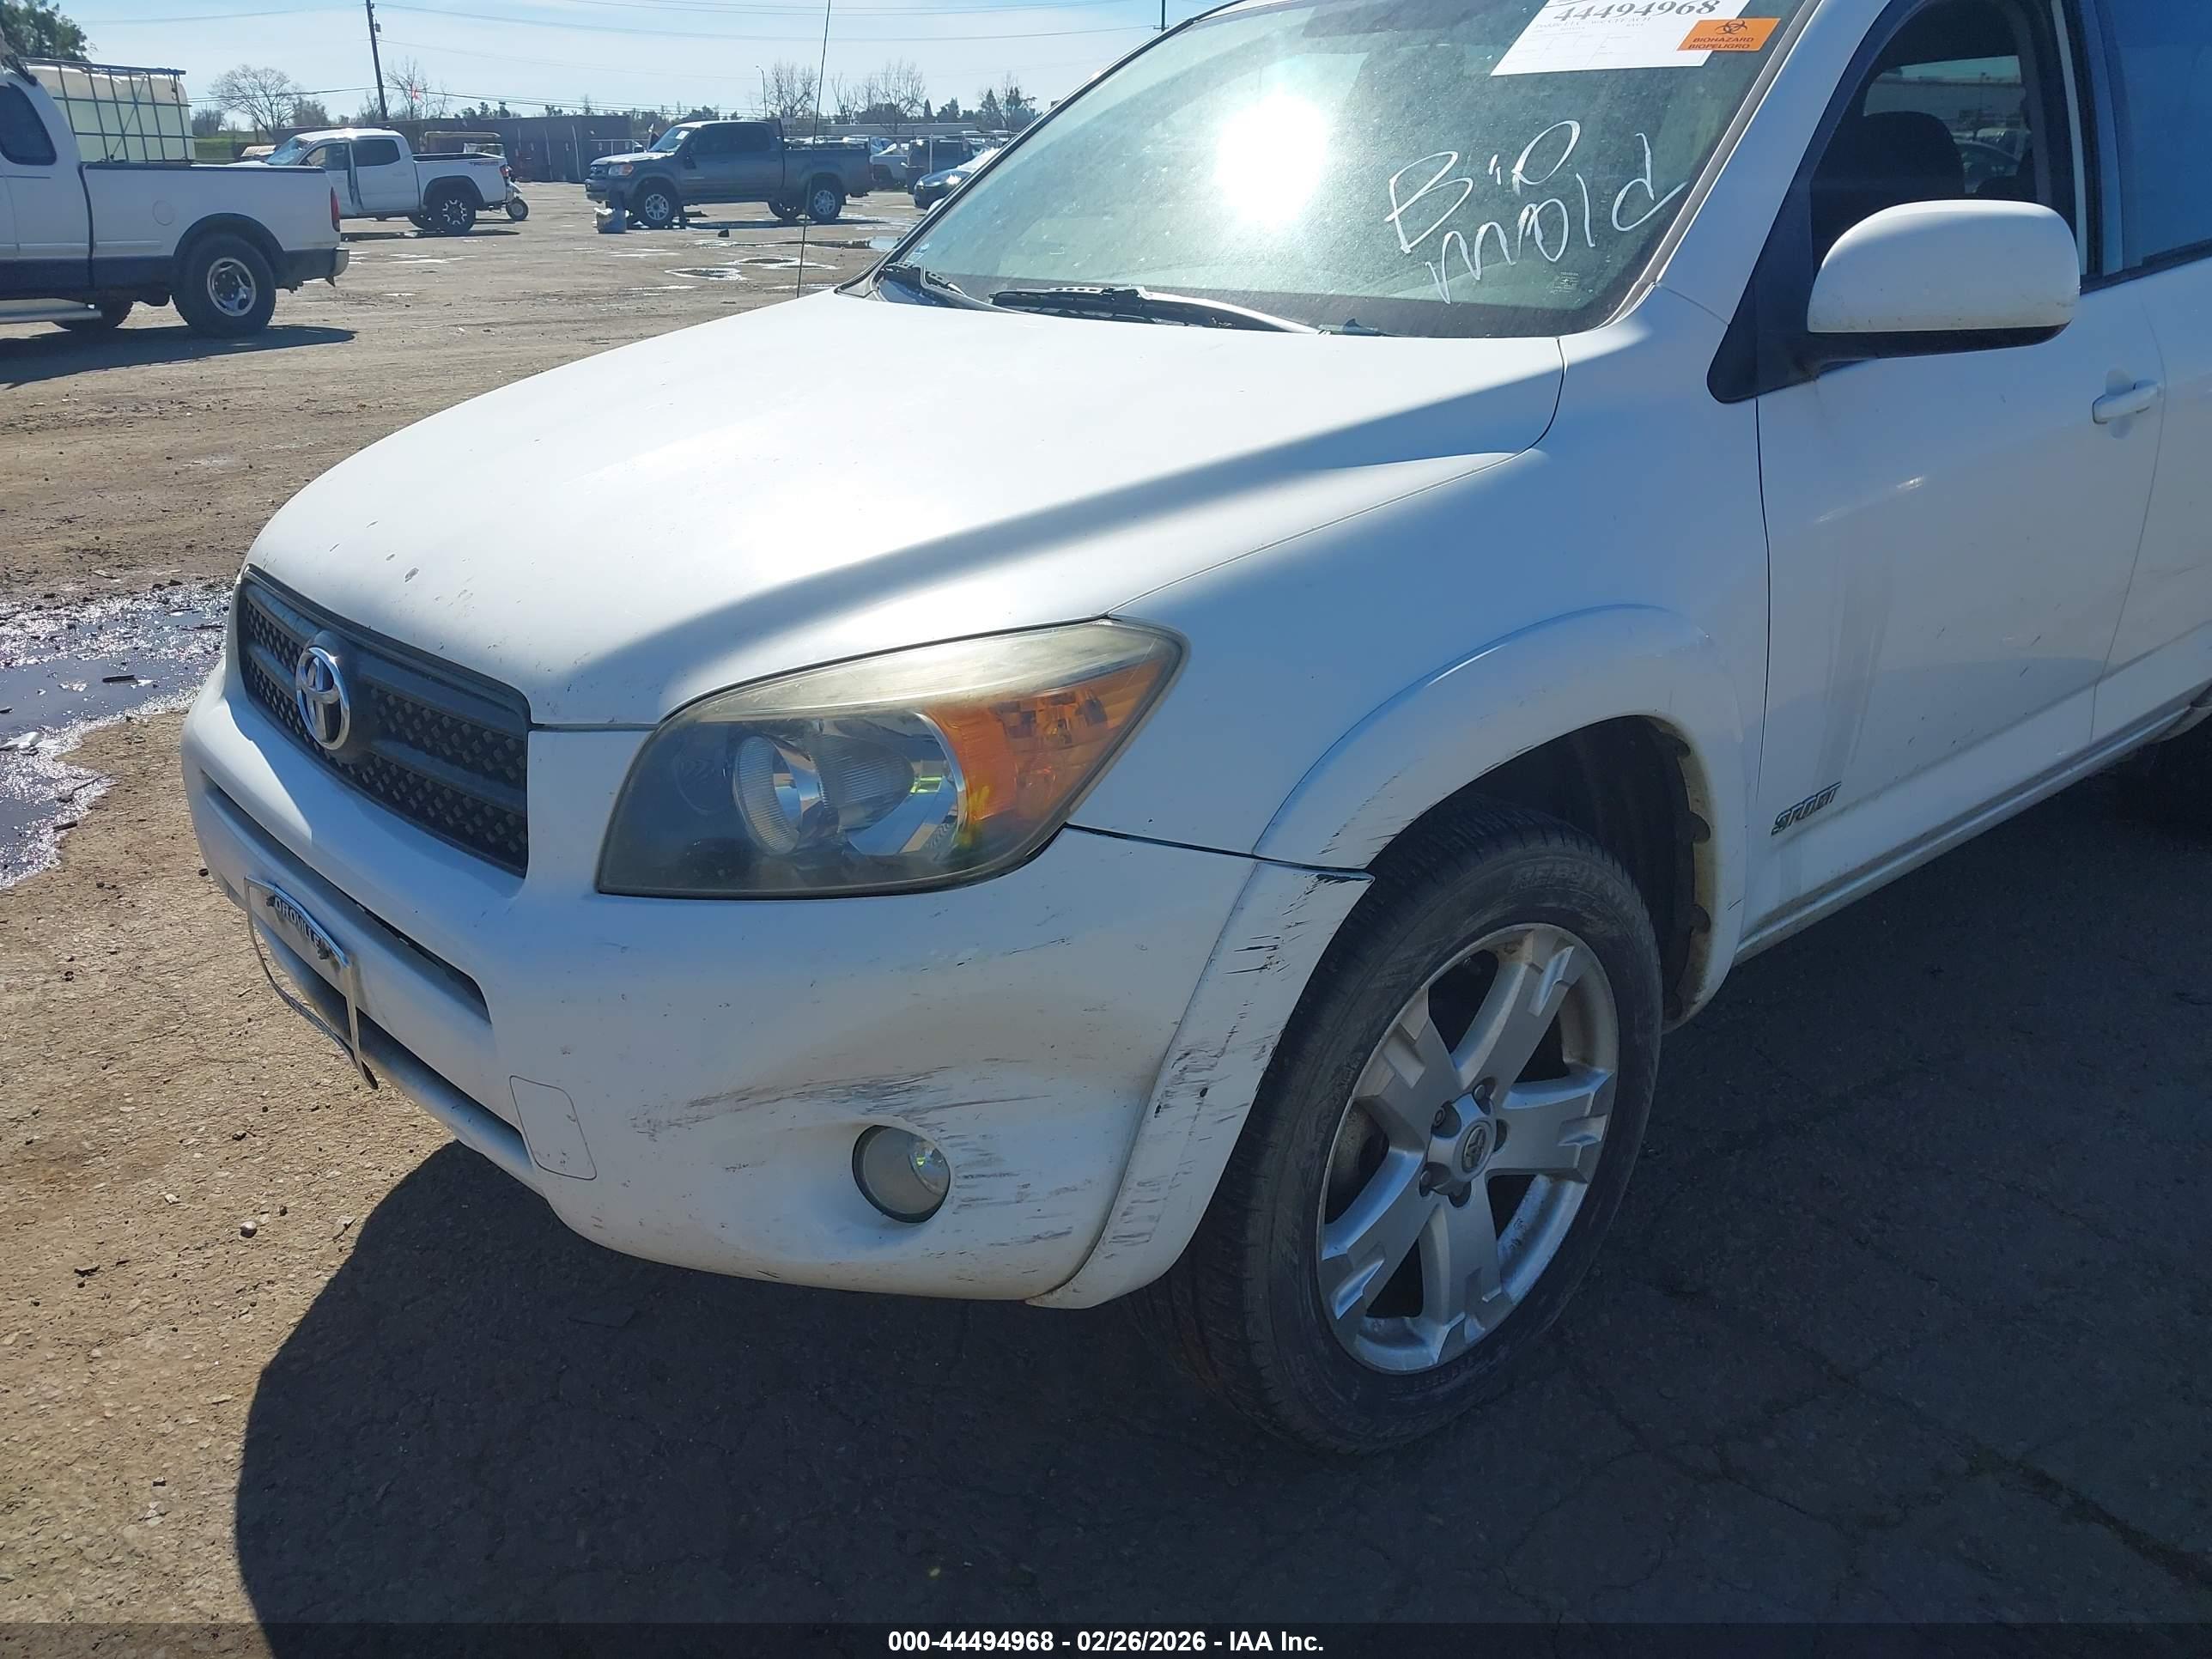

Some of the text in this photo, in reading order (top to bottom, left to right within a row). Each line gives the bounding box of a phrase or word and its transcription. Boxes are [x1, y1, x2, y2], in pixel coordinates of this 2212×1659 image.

[1553, 0, 1718, 21] 44494968
[1771, 781, 1842, 836] SPORT
[274, 896, 321, 951] OROVILLE
